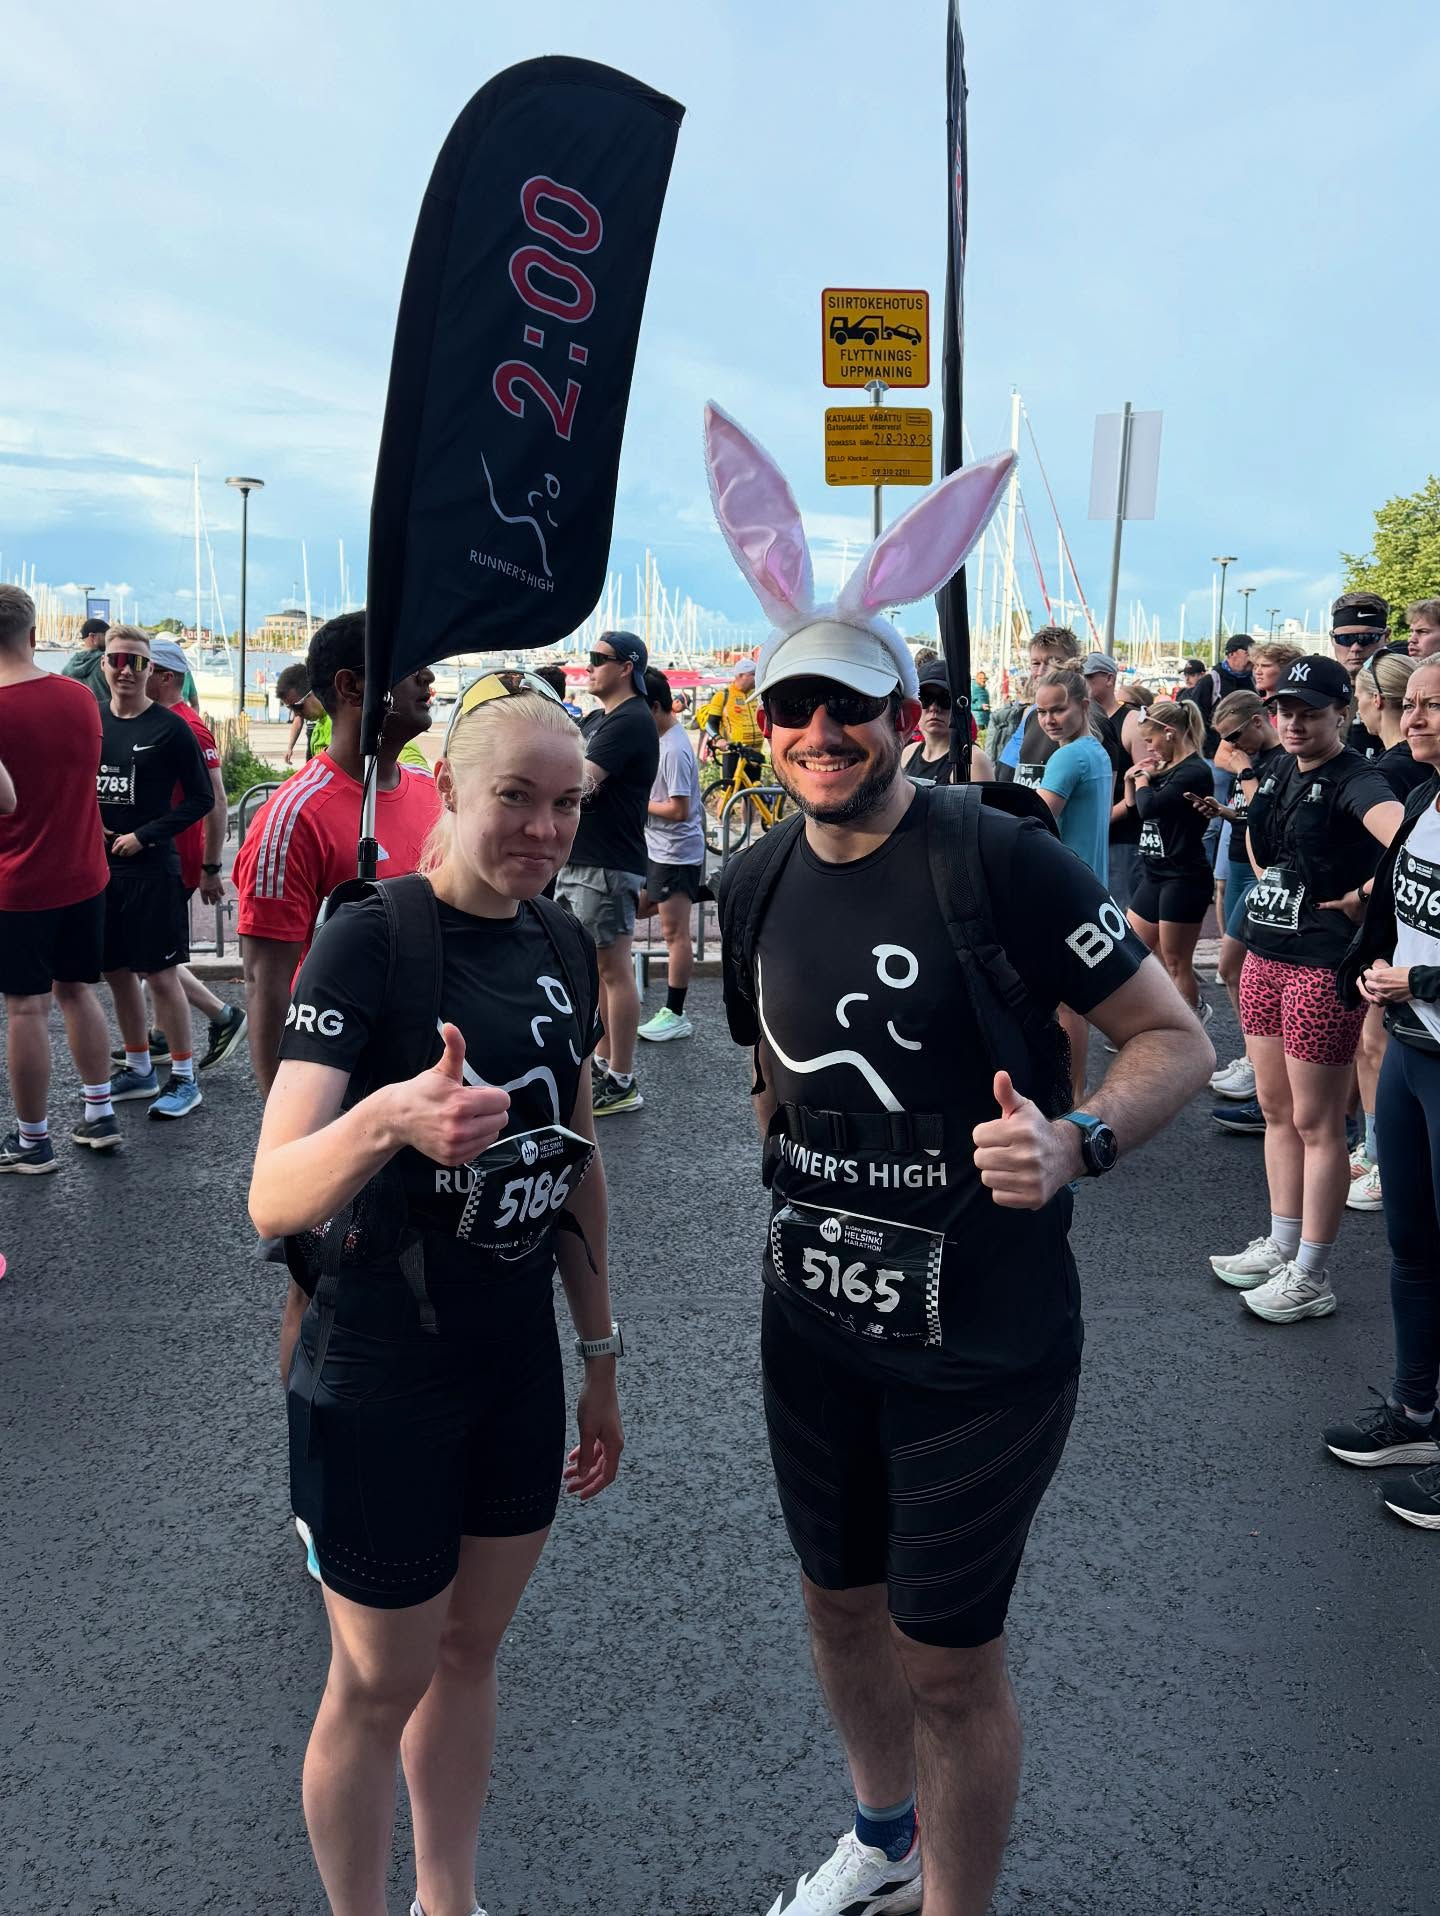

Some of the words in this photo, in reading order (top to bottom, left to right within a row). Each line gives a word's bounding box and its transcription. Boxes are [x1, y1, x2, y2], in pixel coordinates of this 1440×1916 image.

[493, 175, 603, 440] 2:00
[828, 296, 924, 310] SIIRTOKEHOTUS
[840, 349, 918, 361] FLYTTNINGS-
[840, 366, 913, 378] UPPMANING
[827, 414, 865, 422] KATUALUE
[470, 549, 527, 581] RUNNER'S
[527, 573, 554, 592] HIGH
[1288, 662, 1311, 682] NY
[1250, 885, 1290, 910] 4371
[1396, 874, 1440, 916] 2376
[1065, 894, 1131, 969] BO
[869, 1162, 947, 1188] HIGH
[493, 1164, 573, 1229] 5186
[844, 1230, 883, 1246] HELSINKI
[844, 1238, 882, 1252] MARATHON
[802, 1247, 906, 1313] 5165
